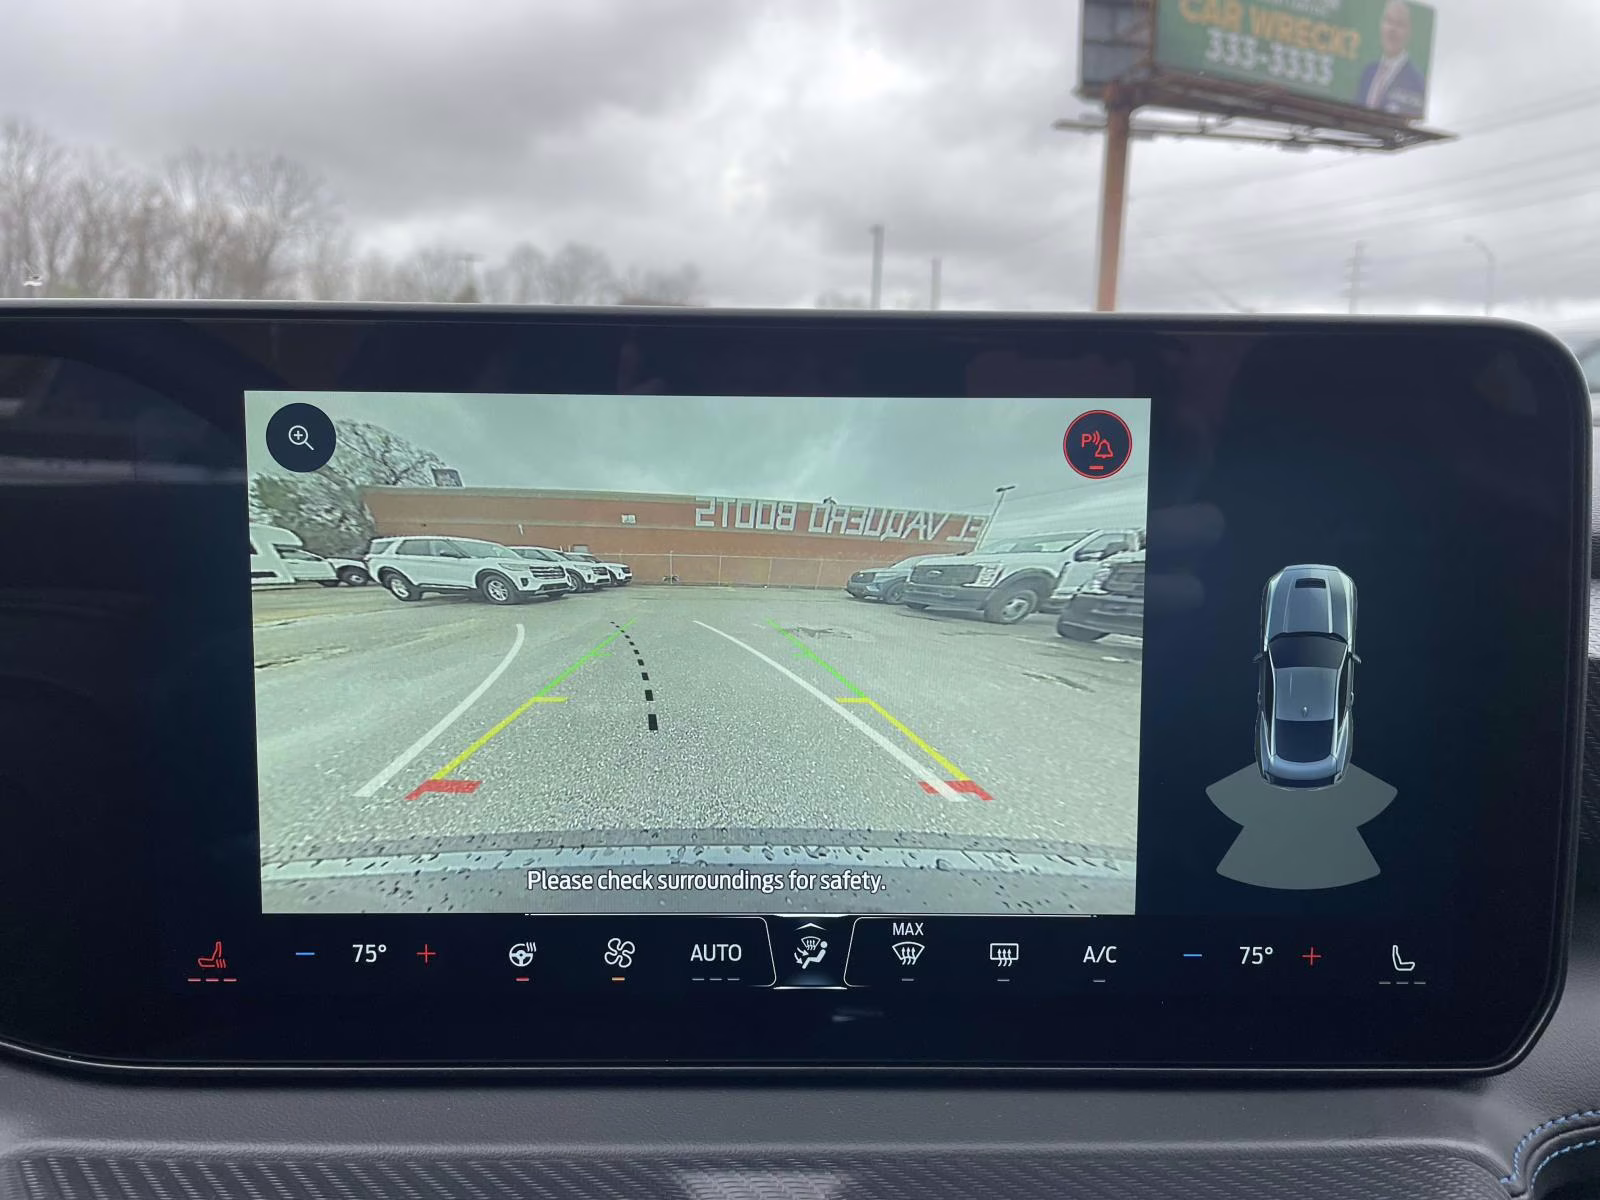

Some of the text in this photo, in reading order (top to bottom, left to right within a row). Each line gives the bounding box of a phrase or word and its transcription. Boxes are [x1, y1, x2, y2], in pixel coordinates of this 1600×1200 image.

[1178, 0, 1360, 59] CAR WRECK?
[1205, 27, 1335, 86] 333-3333
[1081, 433, 1093, 448] P
[526, 869, 887, 894] Please check surroundings for safety.
[892, 922, 925, 937] MAX
[352, 943, 387, 963] 75°
[690, 943, 742, 963] AUTO
[1082, 945, 1118, 965] A/C
[1239, 946, 1274, 965] 75°
